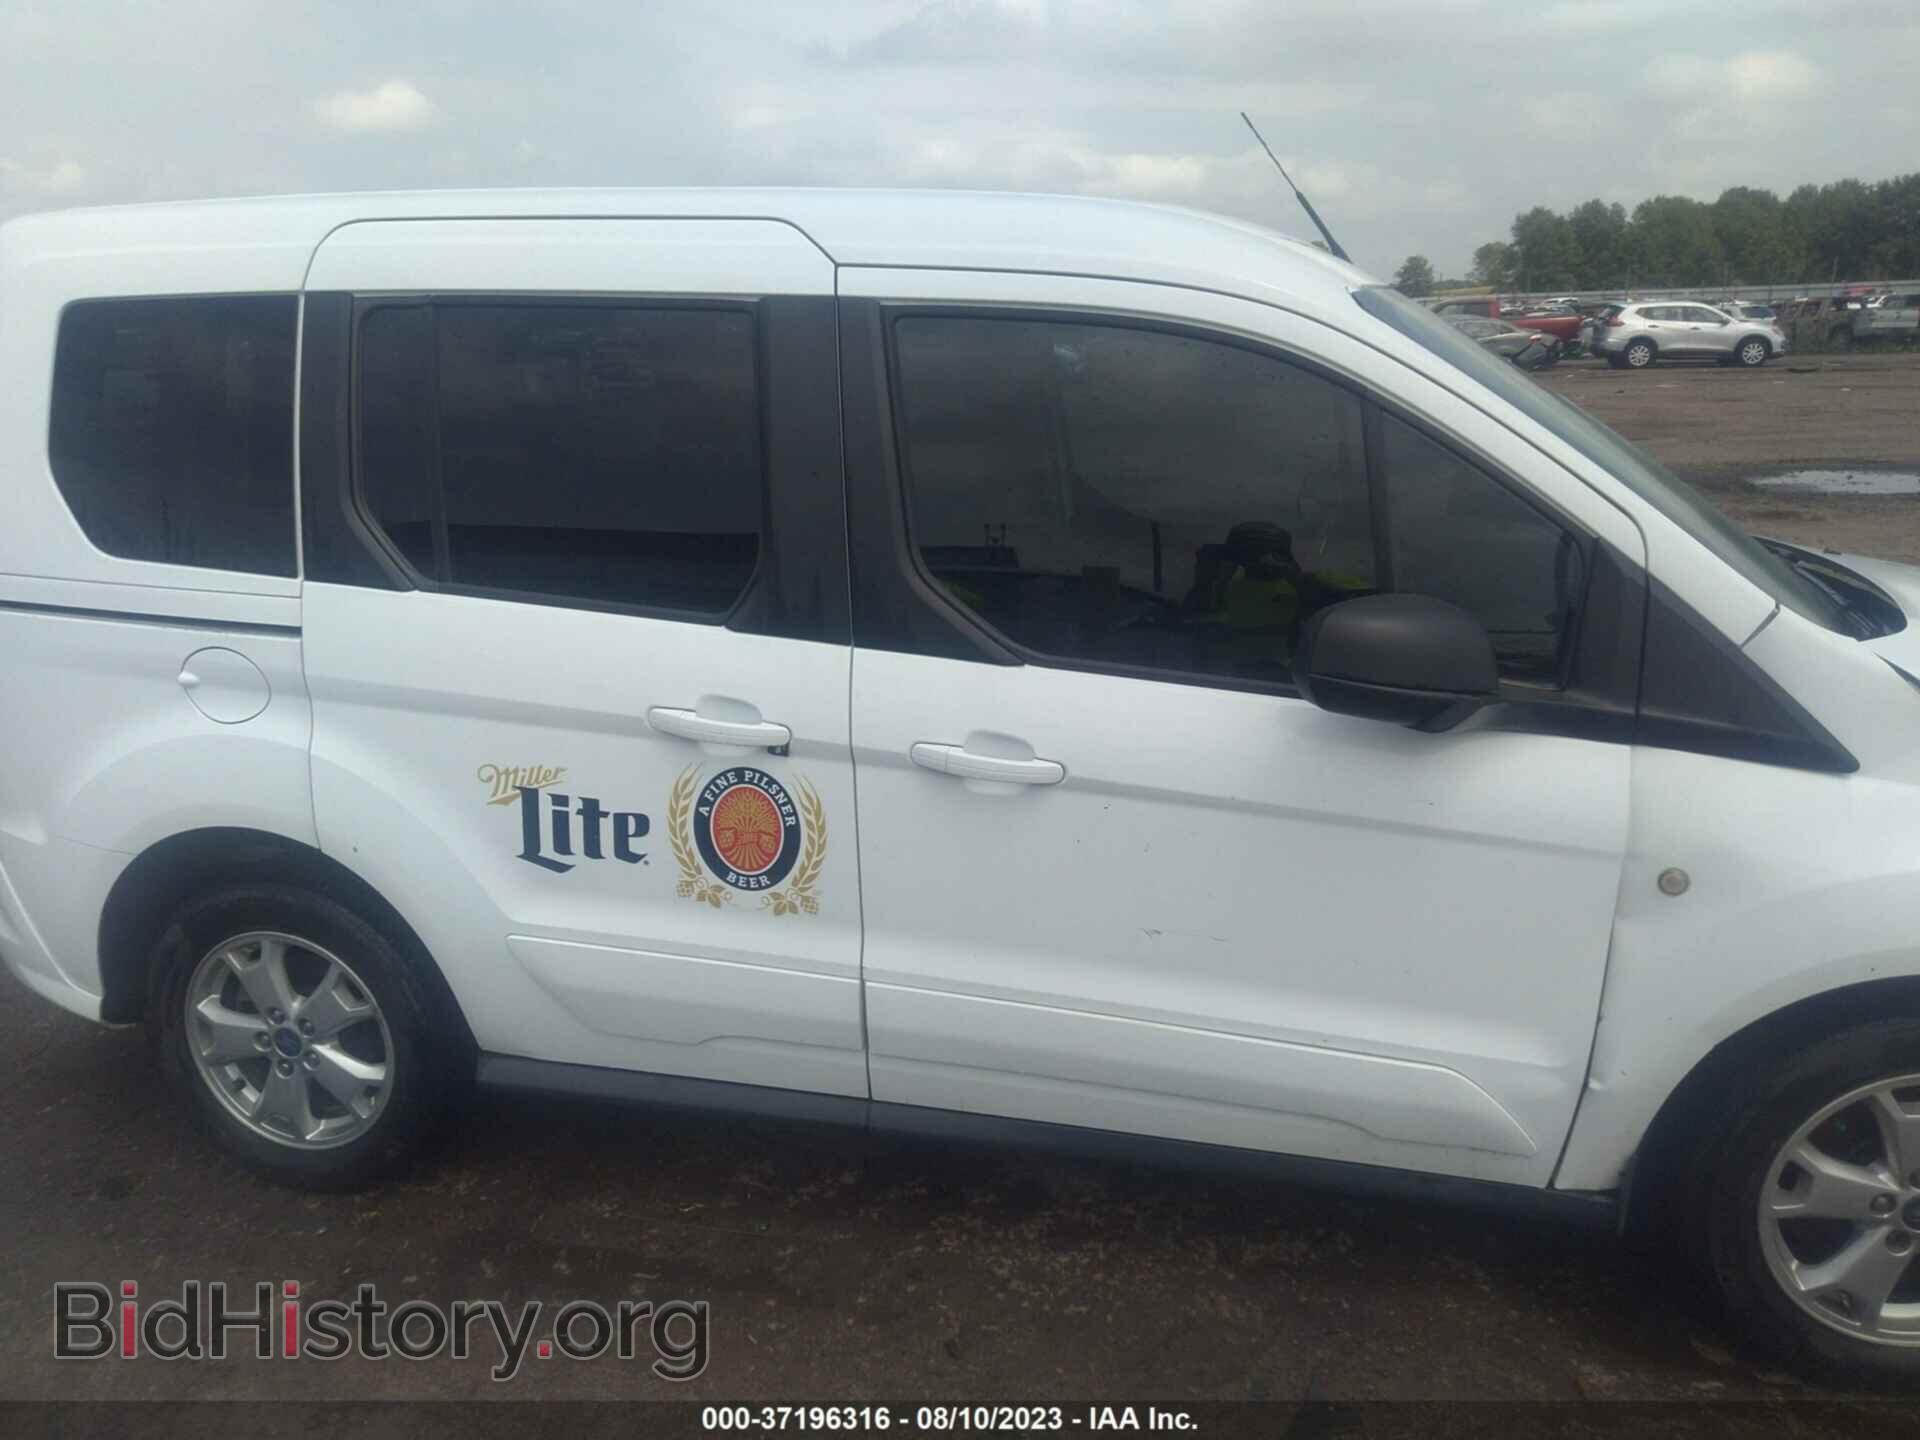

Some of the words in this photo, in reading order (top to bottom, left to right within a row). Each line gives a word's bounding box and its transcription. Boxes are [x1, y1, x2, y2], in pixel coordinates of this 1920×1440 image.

[477, 764, 568, 806] Miller
[699, 805, 710, 817] A
[705, 771, 738, 801] FINE
[744, 770, 796, 827] PILSNER
[512, 785, 650, 874] Lite
[726, 872, 771, 888] BEER
